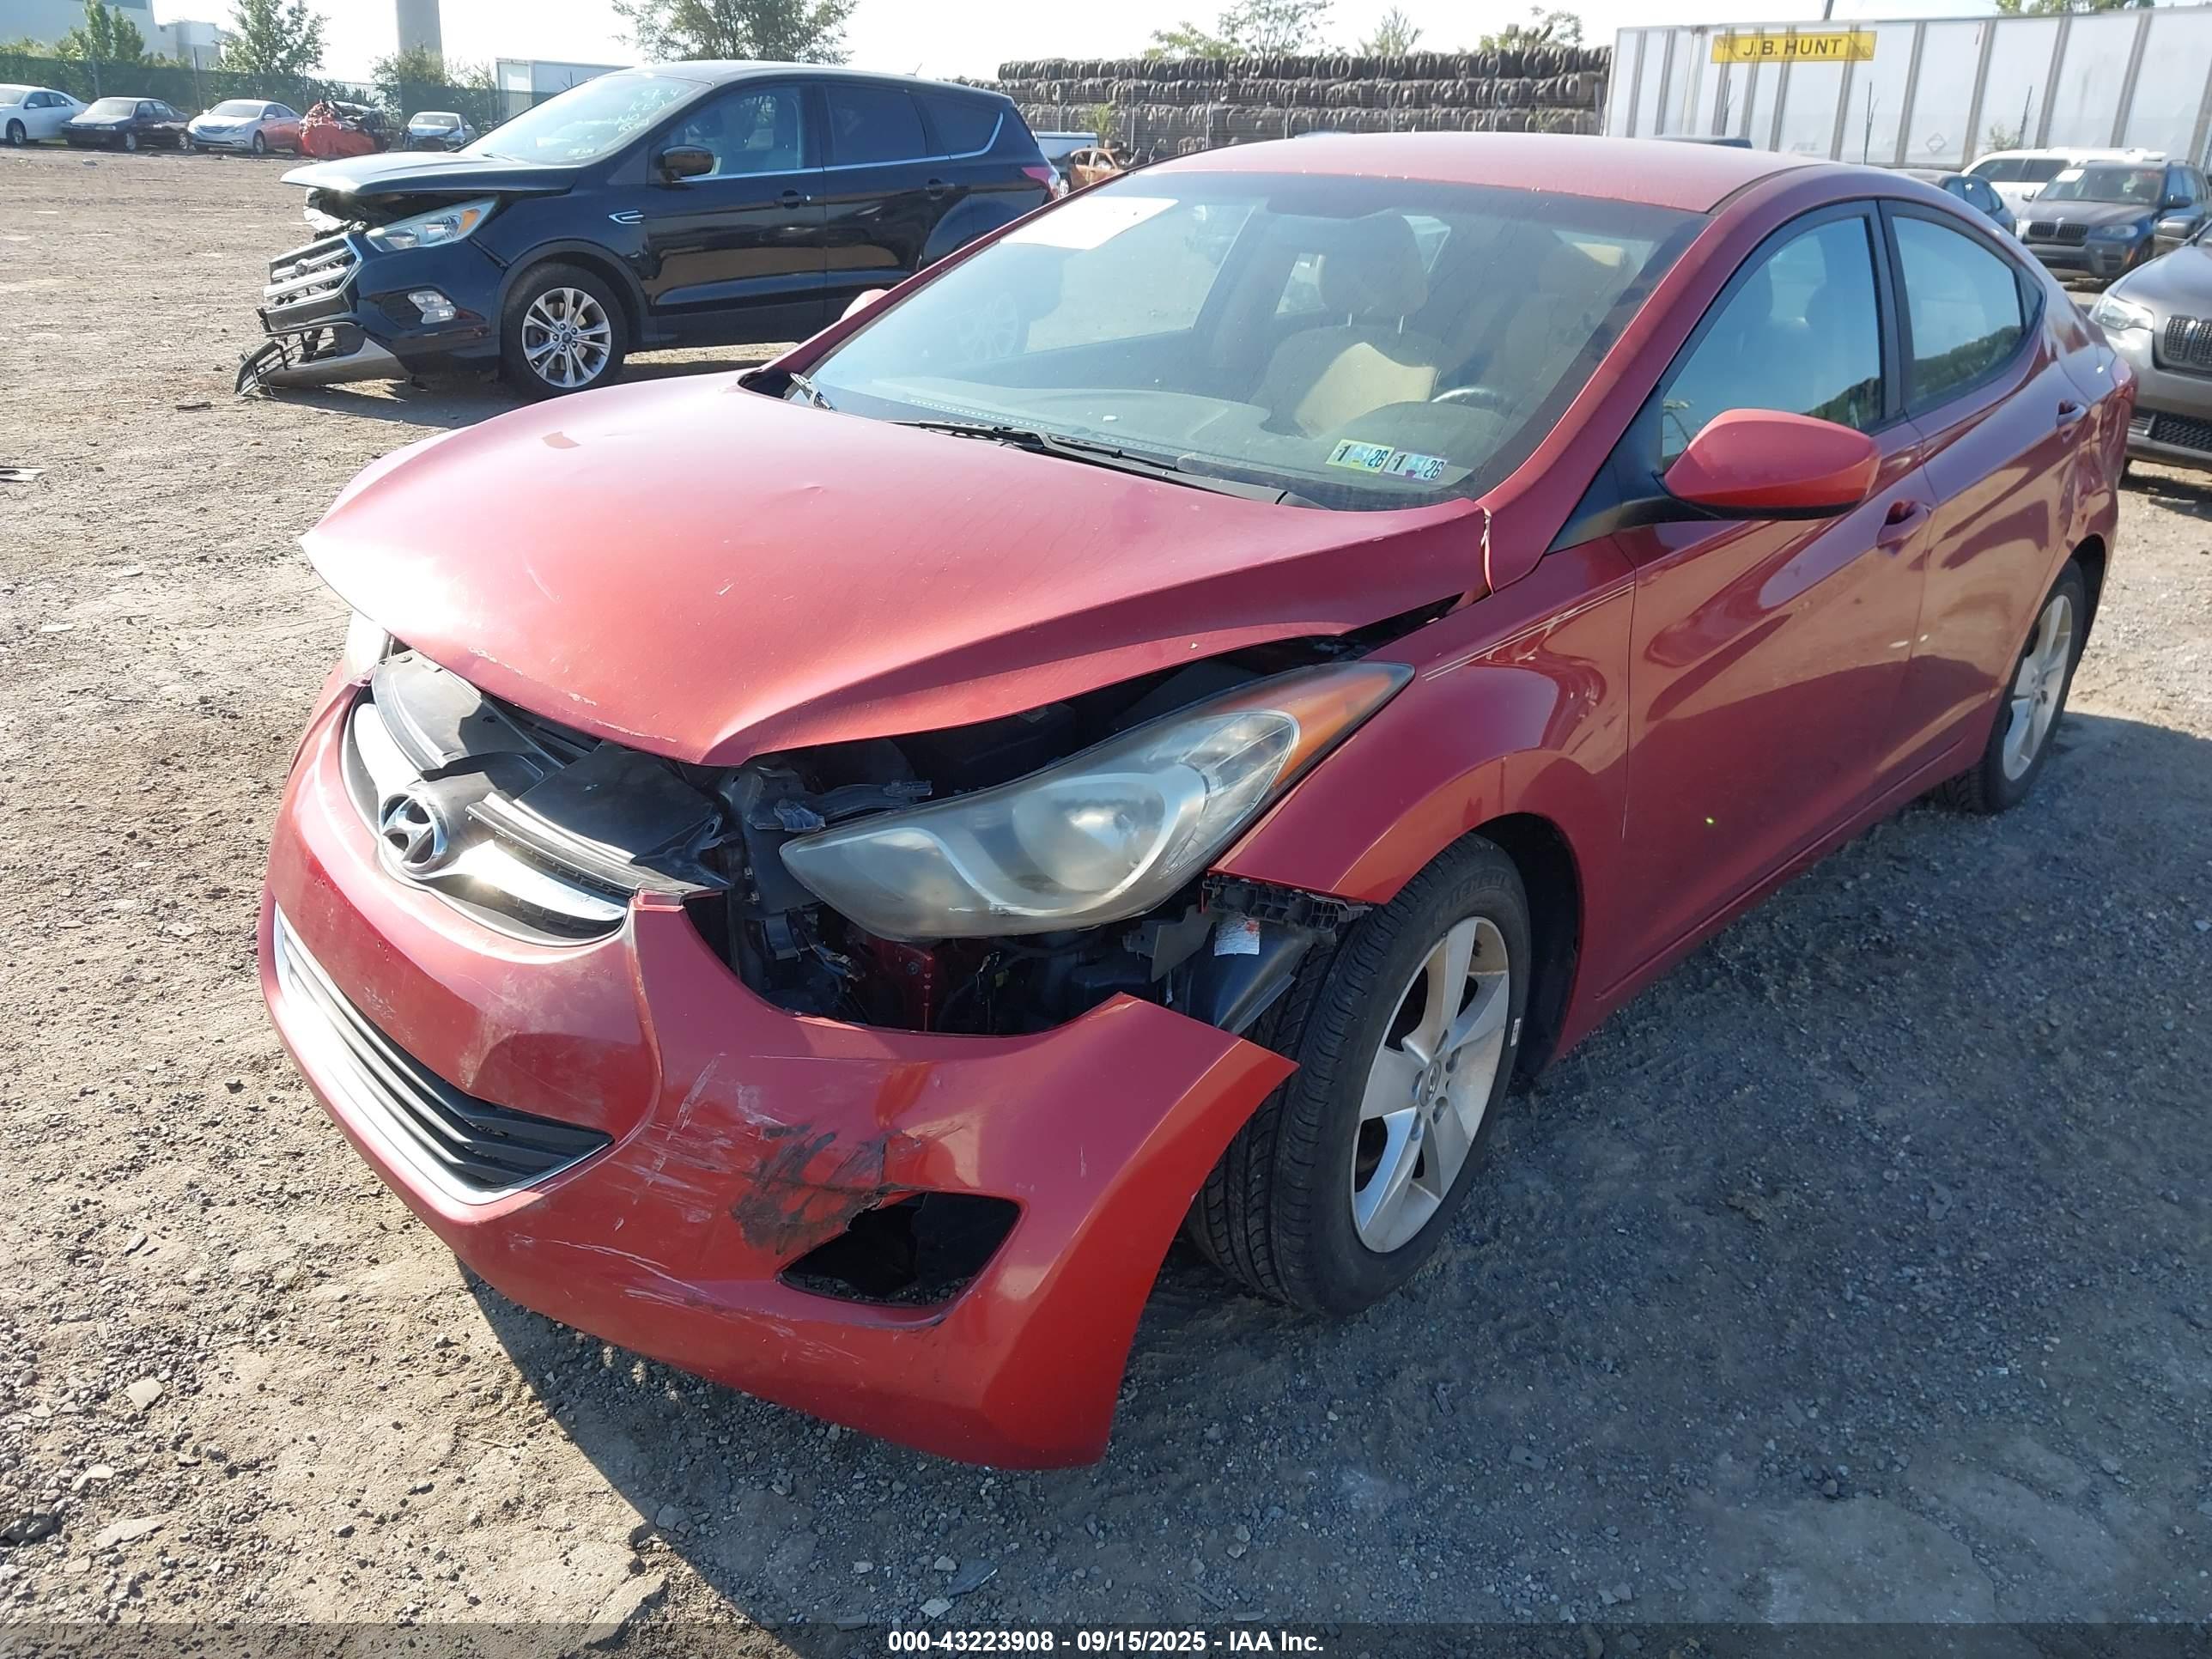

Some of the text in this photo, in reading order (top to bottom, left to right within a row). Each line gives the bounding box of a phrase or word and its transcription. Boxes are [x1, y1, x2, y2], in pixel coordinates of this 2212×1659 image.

[1784, 39, 1842, 55] HUNT
[1338, 445, 1389, 468] 1 26
[1393, 453, 1445, 479] 1 26
